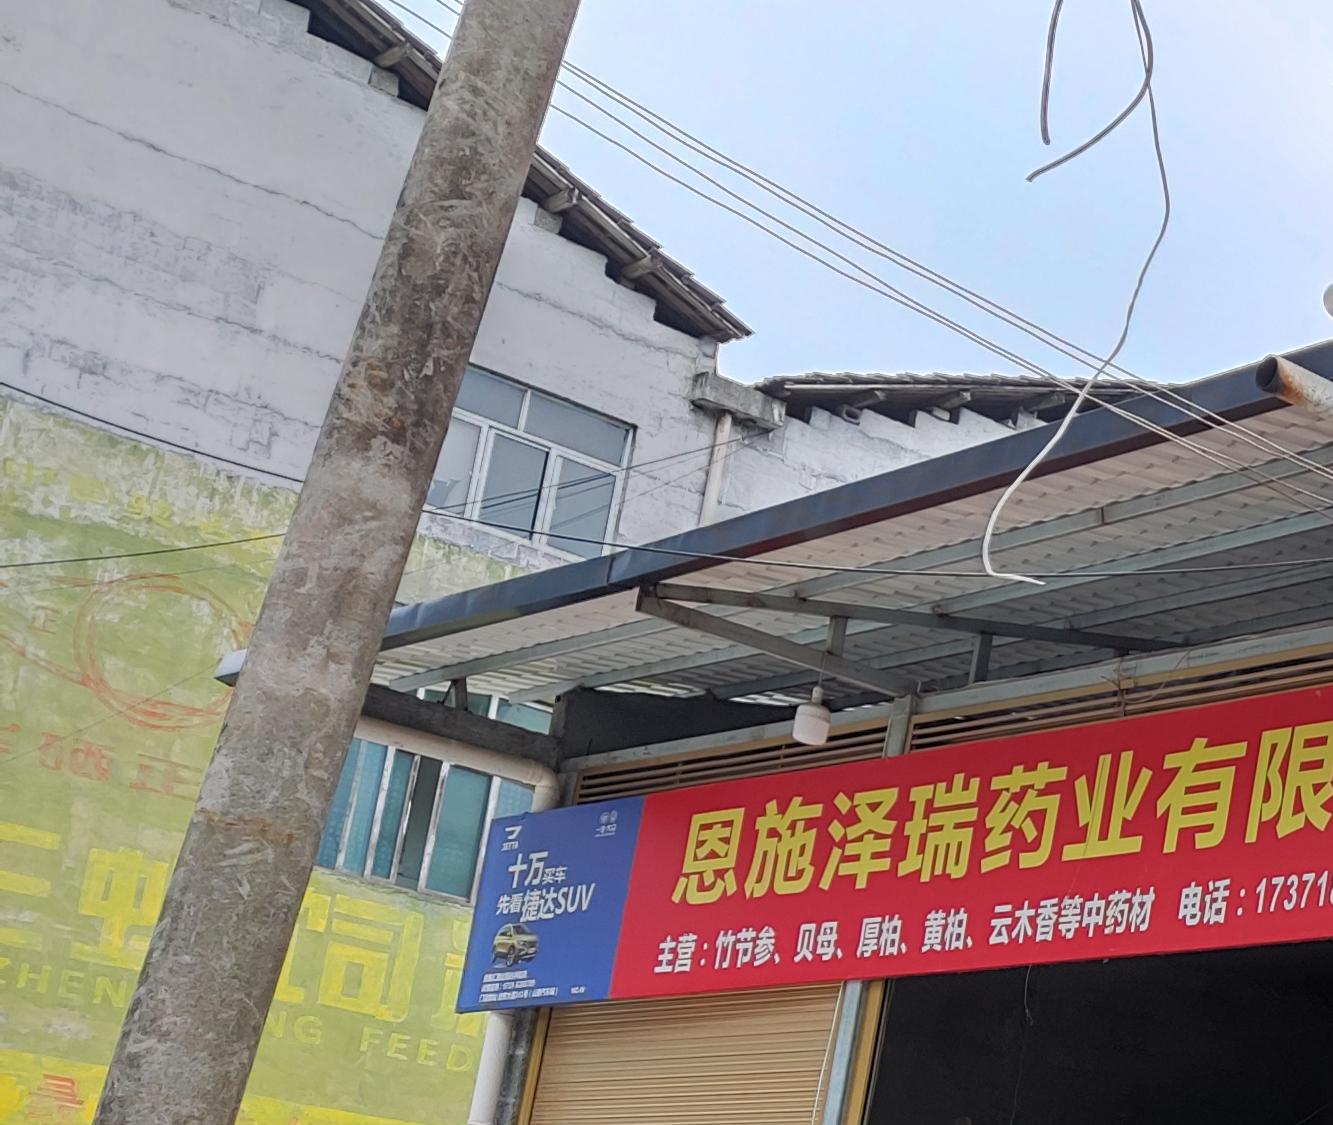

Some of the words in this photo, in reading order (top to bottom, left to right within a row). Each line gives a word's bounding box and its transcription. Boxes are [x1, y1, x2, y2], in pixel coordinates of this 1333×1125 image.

[508, 851, 567, 889] 十万买车
[496, 883, 596, 922] 先看捷达SUV
[361, 1027, 474, 1073] FEED
